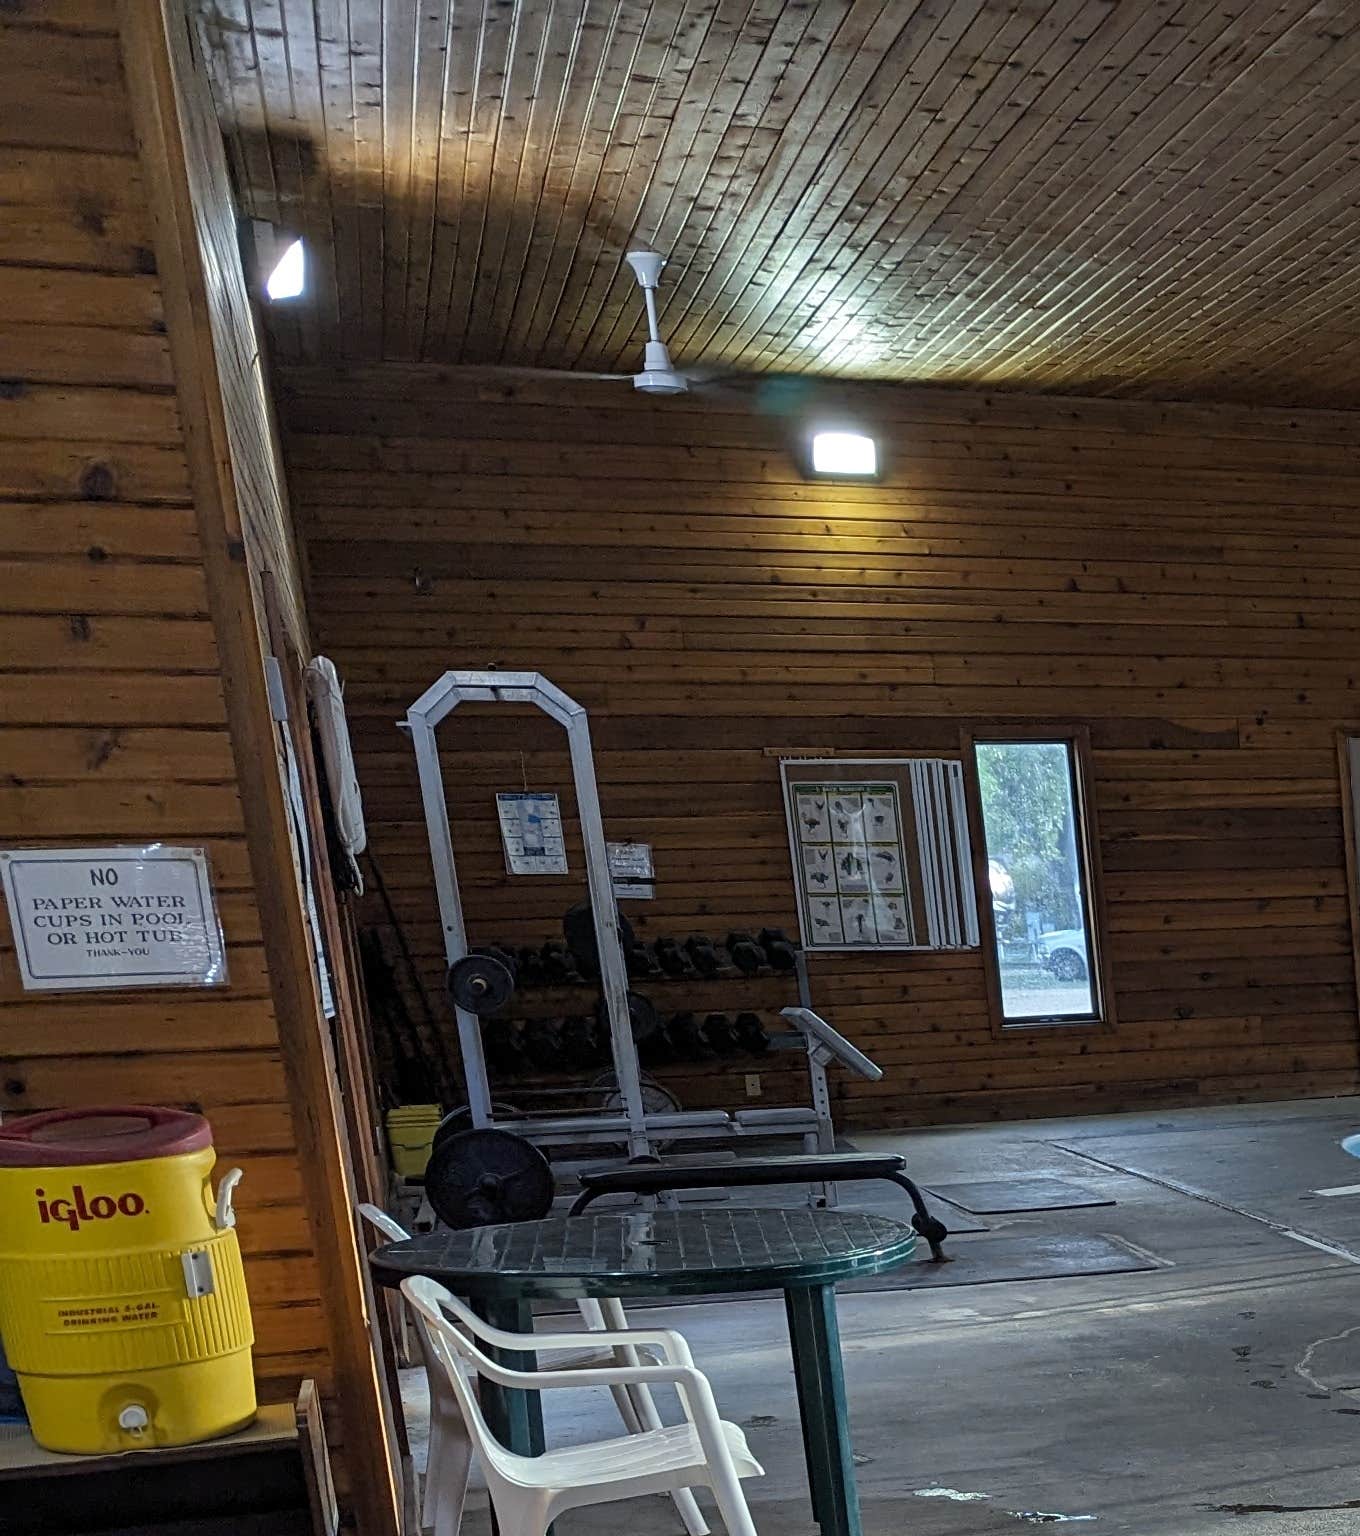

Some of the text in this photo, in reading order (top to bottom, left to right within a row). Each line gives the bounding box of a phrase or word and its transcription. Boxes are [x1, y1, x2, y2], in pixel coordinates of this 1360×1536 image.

[90, 868, 118, 886] NO
[32, 895, 187, 911] PAPER WATER
[34, 913, 92, 928] CUPS
[101, 913, 123, 926] IN
[47, 930, 183, 945] OR HOT TUB
[122, 1312, 158, 1322] WATER
